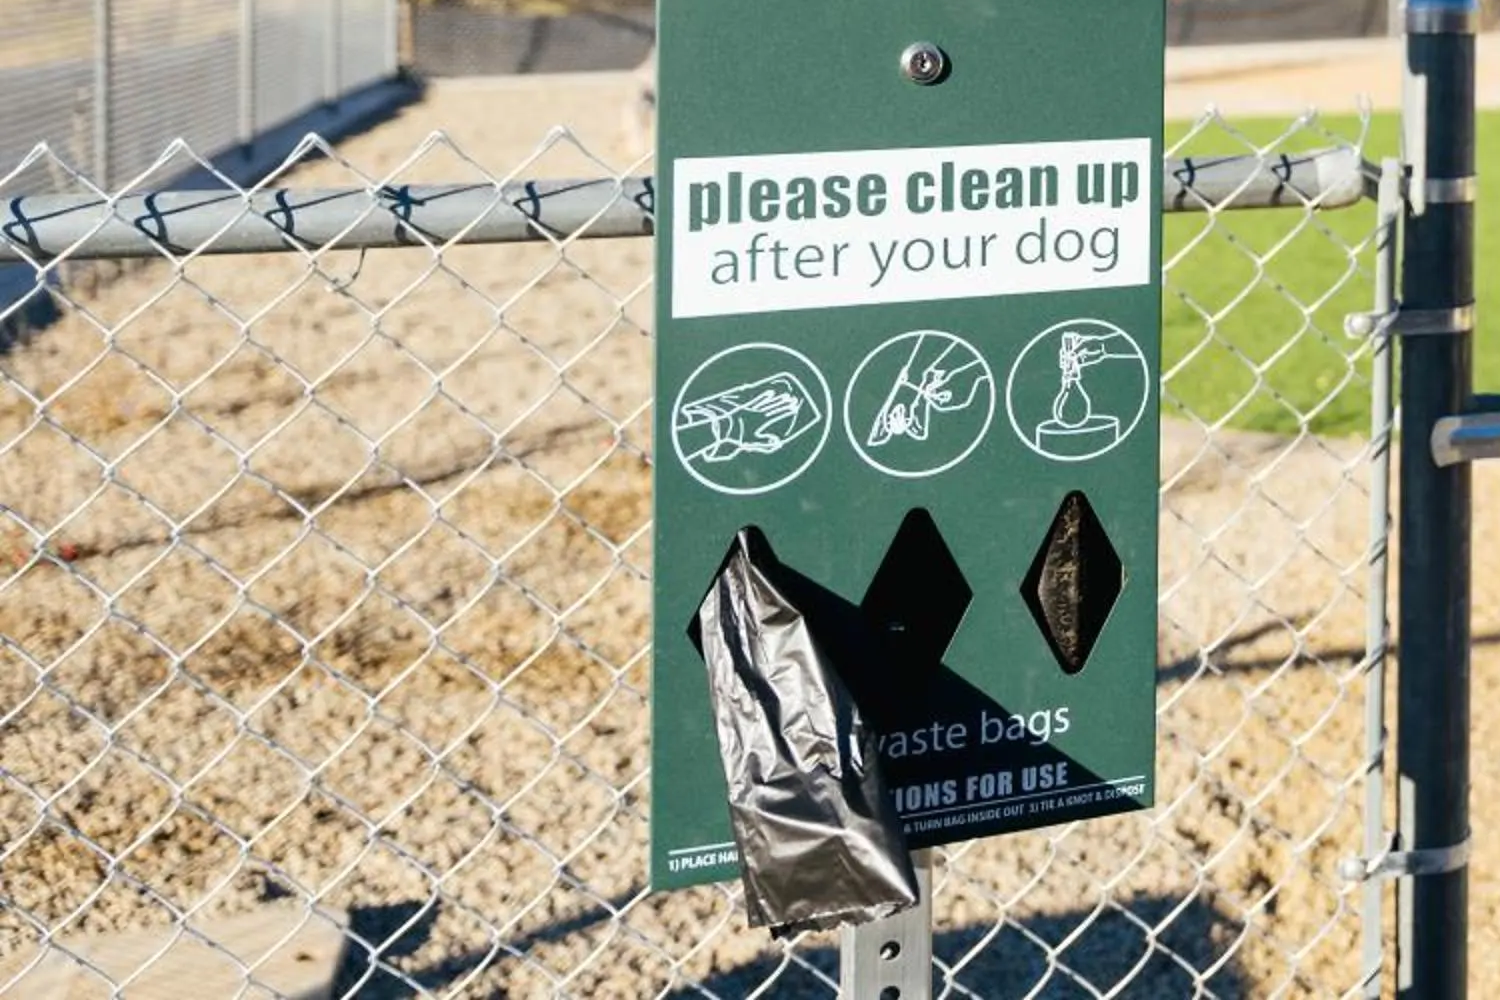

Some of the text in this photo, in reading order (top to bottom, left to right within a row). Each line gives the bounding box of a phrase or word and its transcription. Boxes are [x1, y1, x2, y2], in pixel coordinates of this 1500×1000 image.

[688, 159, 1139, 232] please clean up
[710, 216, 1120, 288] after your dog
[879, 706, 1070, 758] aste bags
[890, 761, 1068, 812] IONS FOR USE
[681, 852, 717, 870] PLACE
[913, 818, 943, 833] TURN
[944, 814, 966, 828] BAG
[967, 808, 1000, 824] INSIDE
[1003, 803, 1024, 817] OUT
[1040, 799, 1056, 812] TIE
[1057, 797, 1064, 808] A
[1066, 792, 1093, 807] KNOT
[1104, 784, 1146, 800] DISPOSE
